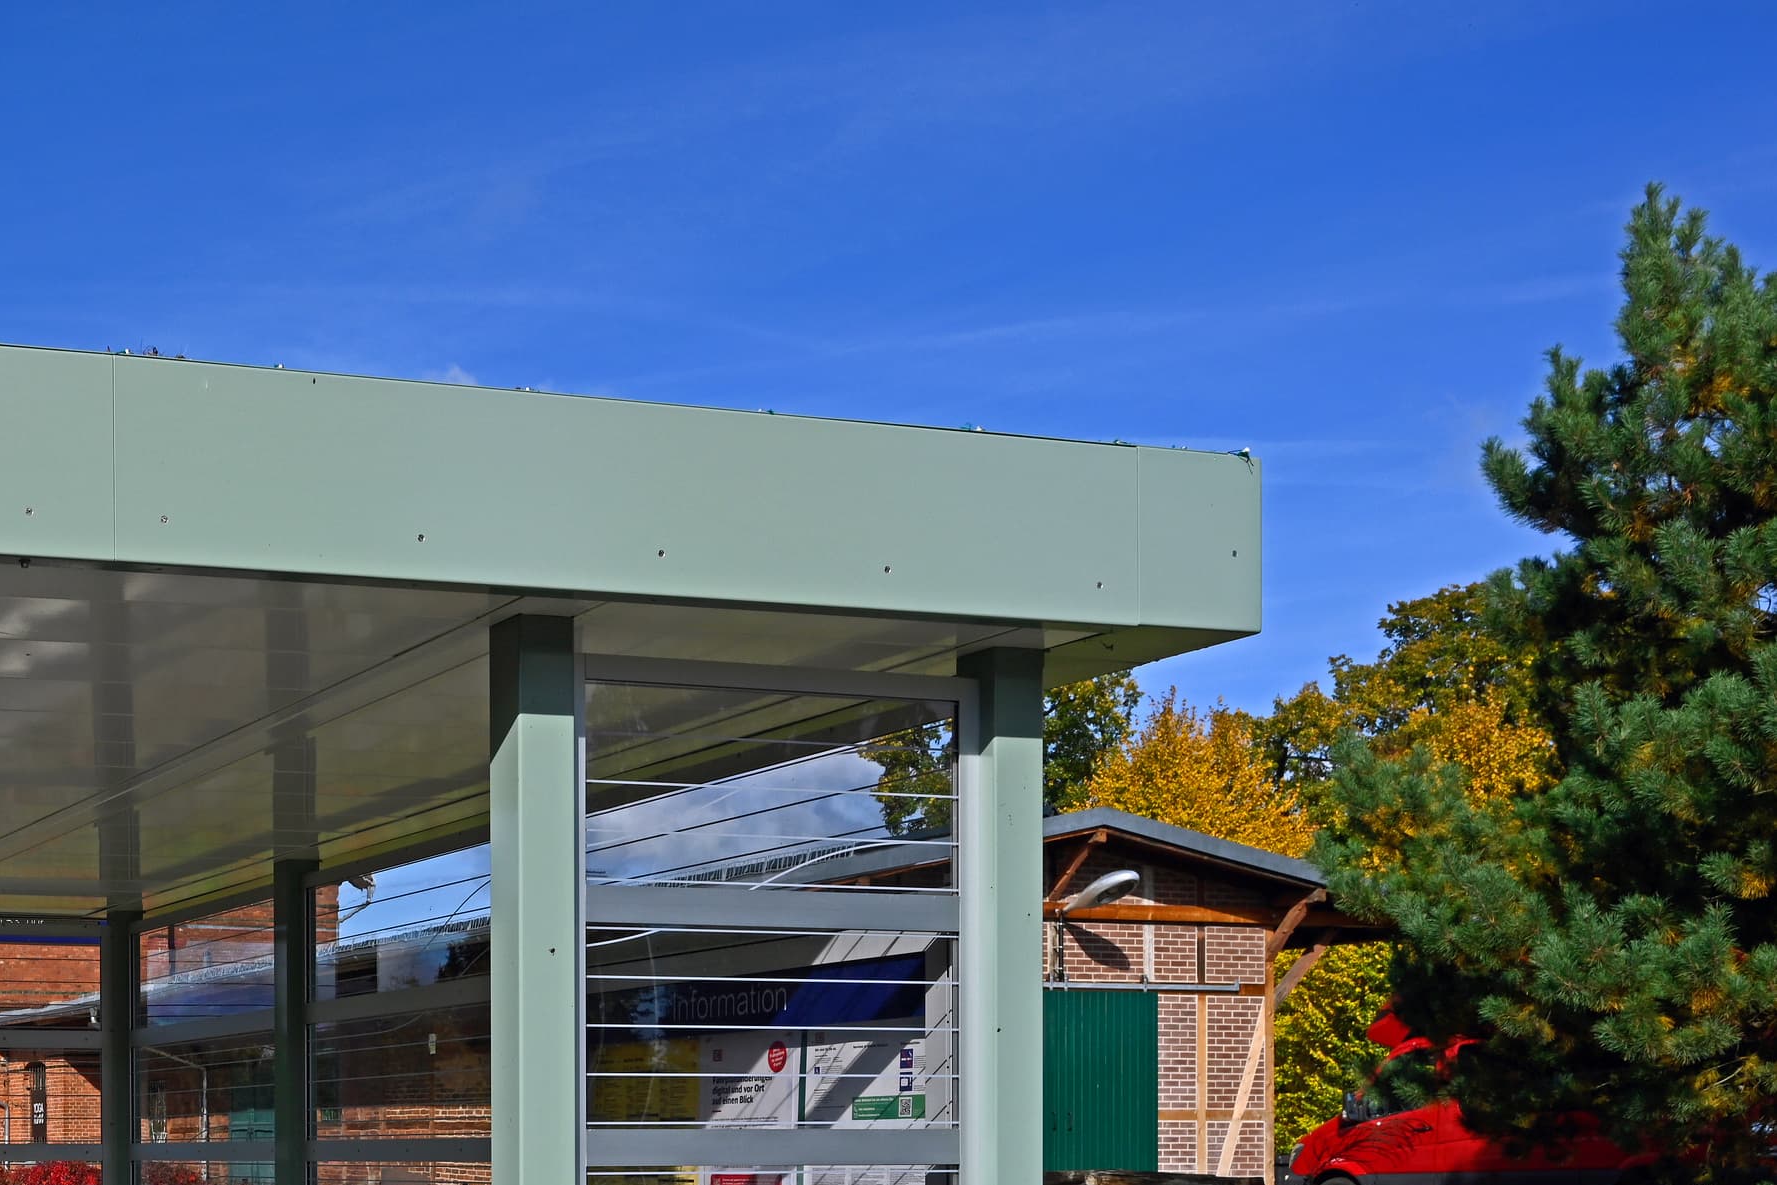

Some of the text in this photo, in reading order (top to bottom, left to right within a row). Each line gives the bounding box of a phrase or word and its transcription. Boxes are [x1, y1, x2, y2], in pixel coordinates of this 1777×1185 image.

[673, 984, 787, 1022] Information
[754, 1084, 765, 1092] Ort
[739, 1095, 754, 1104] Blick
